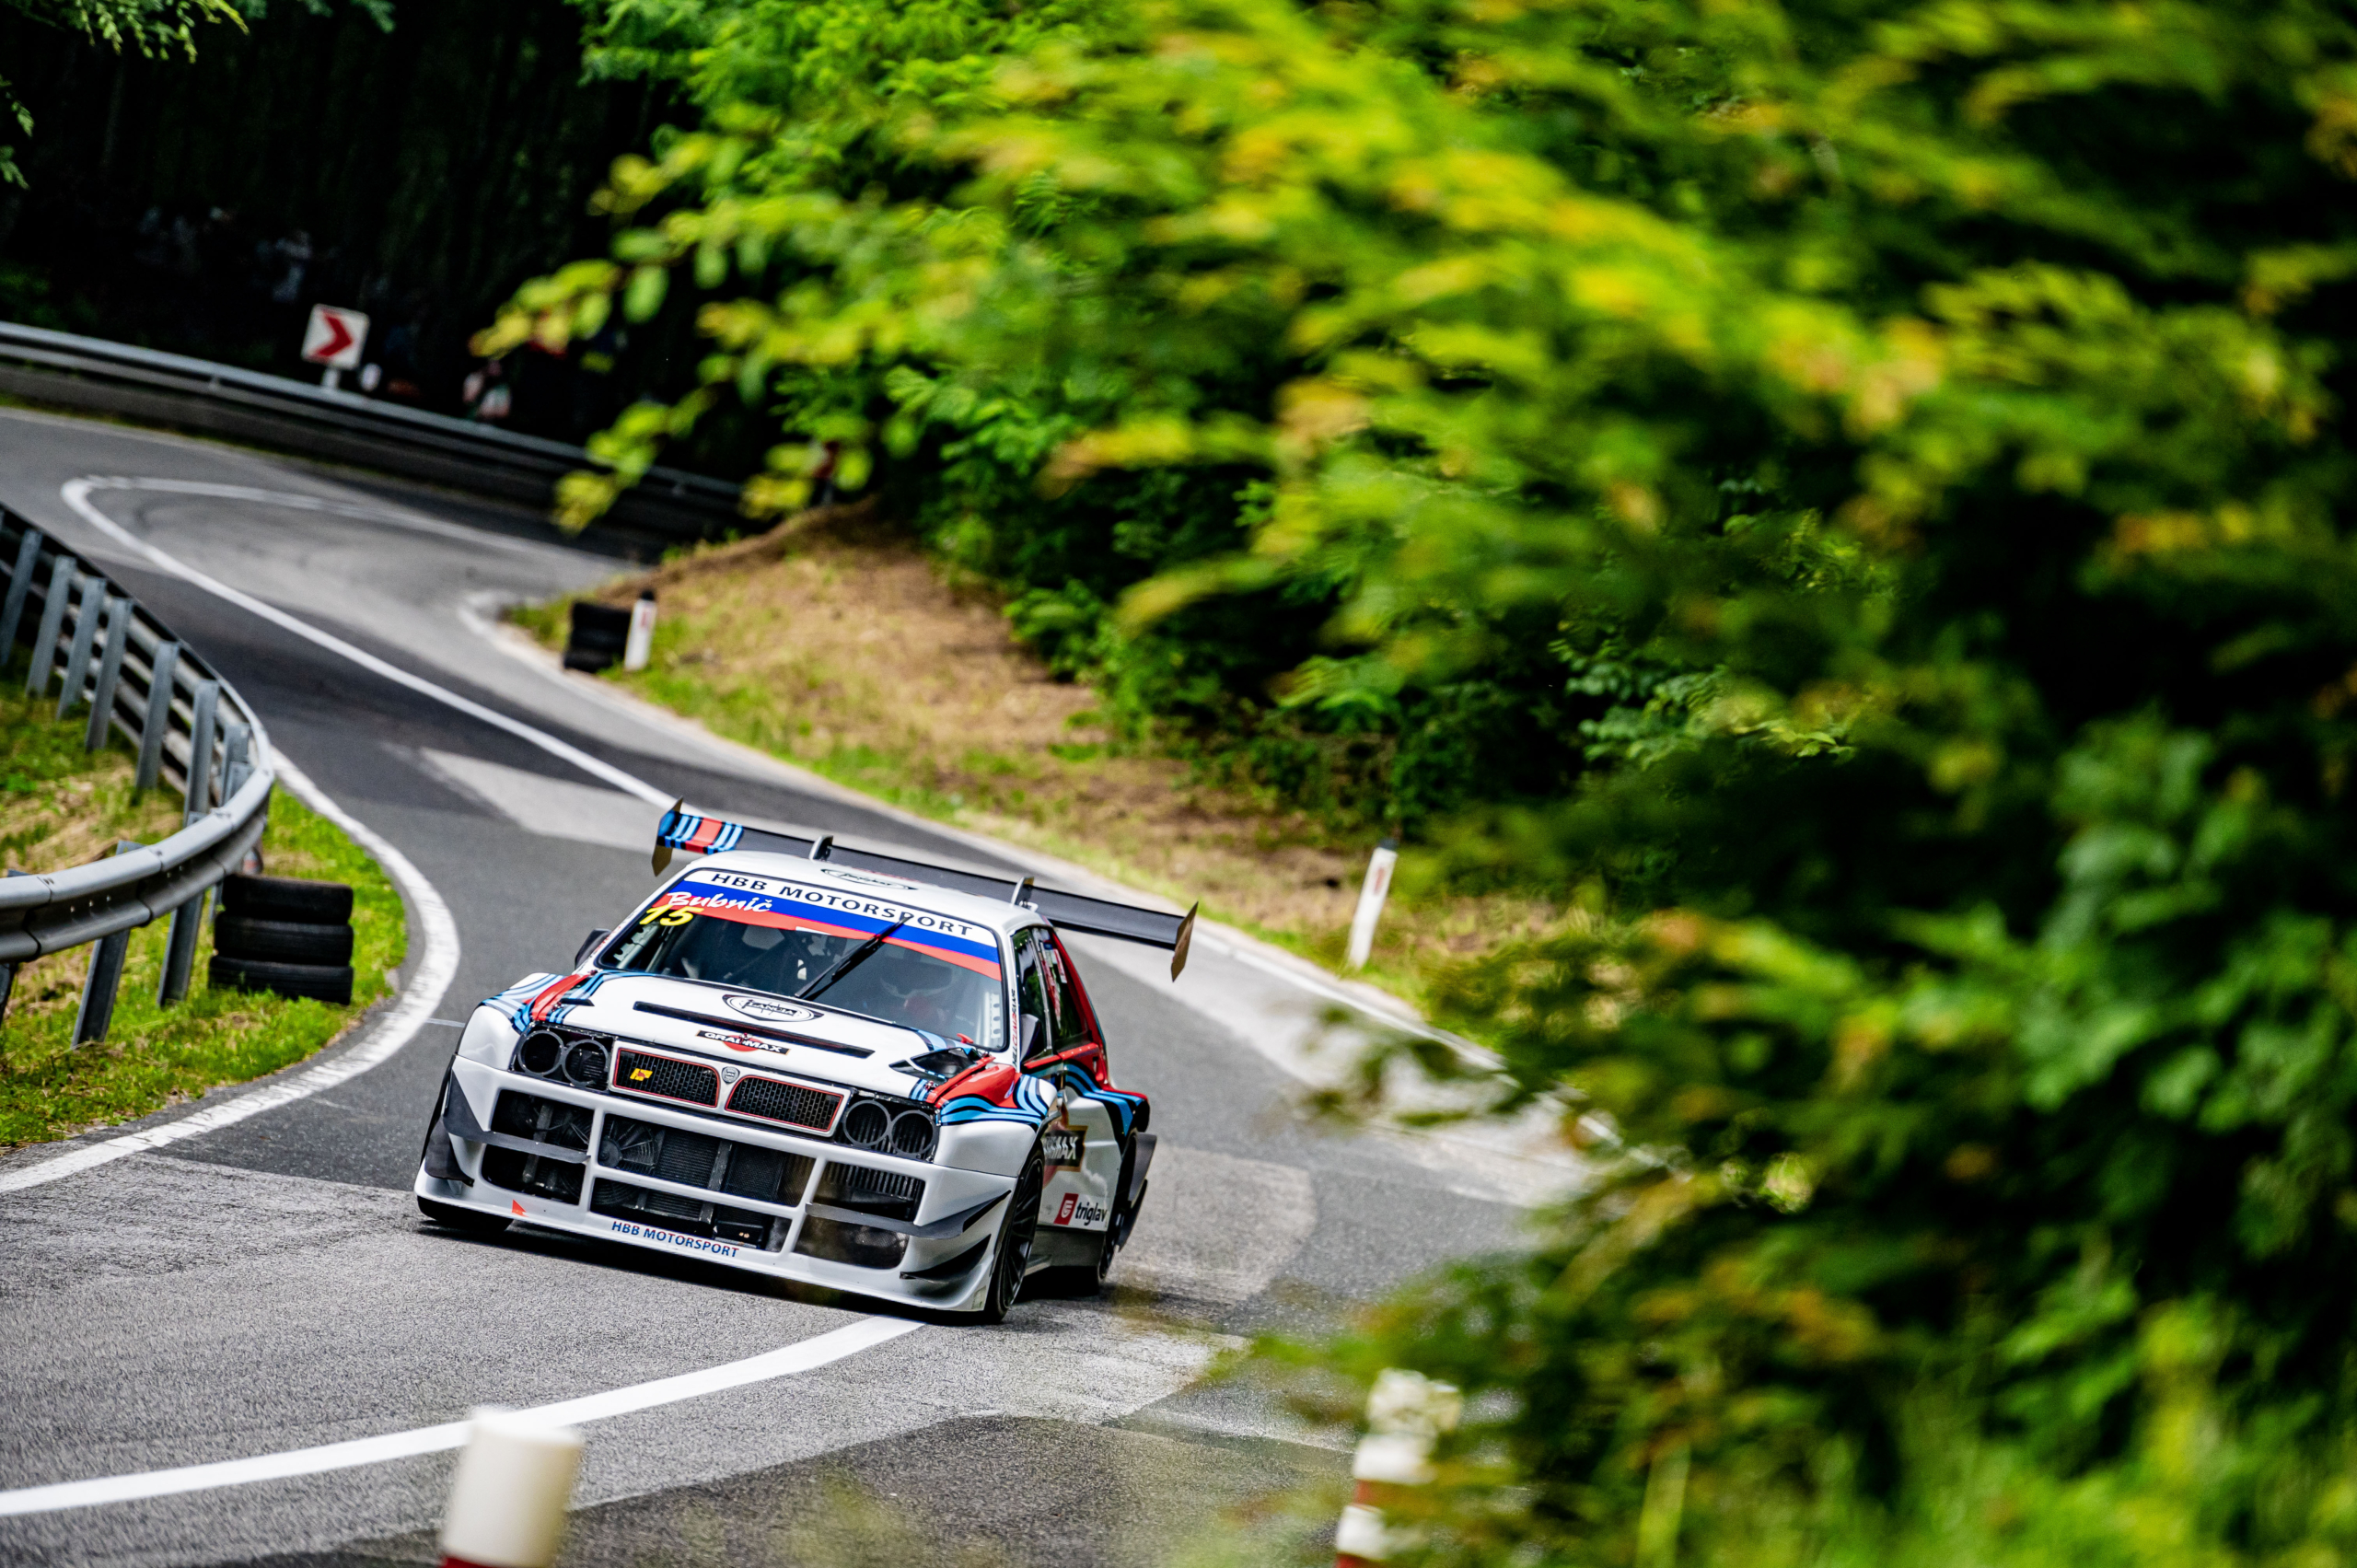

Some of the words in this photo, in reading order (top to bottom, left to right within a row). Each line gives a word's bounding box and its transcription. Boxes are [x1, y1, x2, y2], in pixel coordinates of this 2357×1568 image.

[667, 891, 773, 912] Bubnič
[711, 873, 768, 890] HBB
[778, 886, 973, 936] MOTORSPORT
[639, 904, 705, 926] 15
[1074, 1201, 1109, 1226] triglav
[611, 1220, 641, 1236] HBB
[643, 1227, 739, 1258] MOTORSPORT
